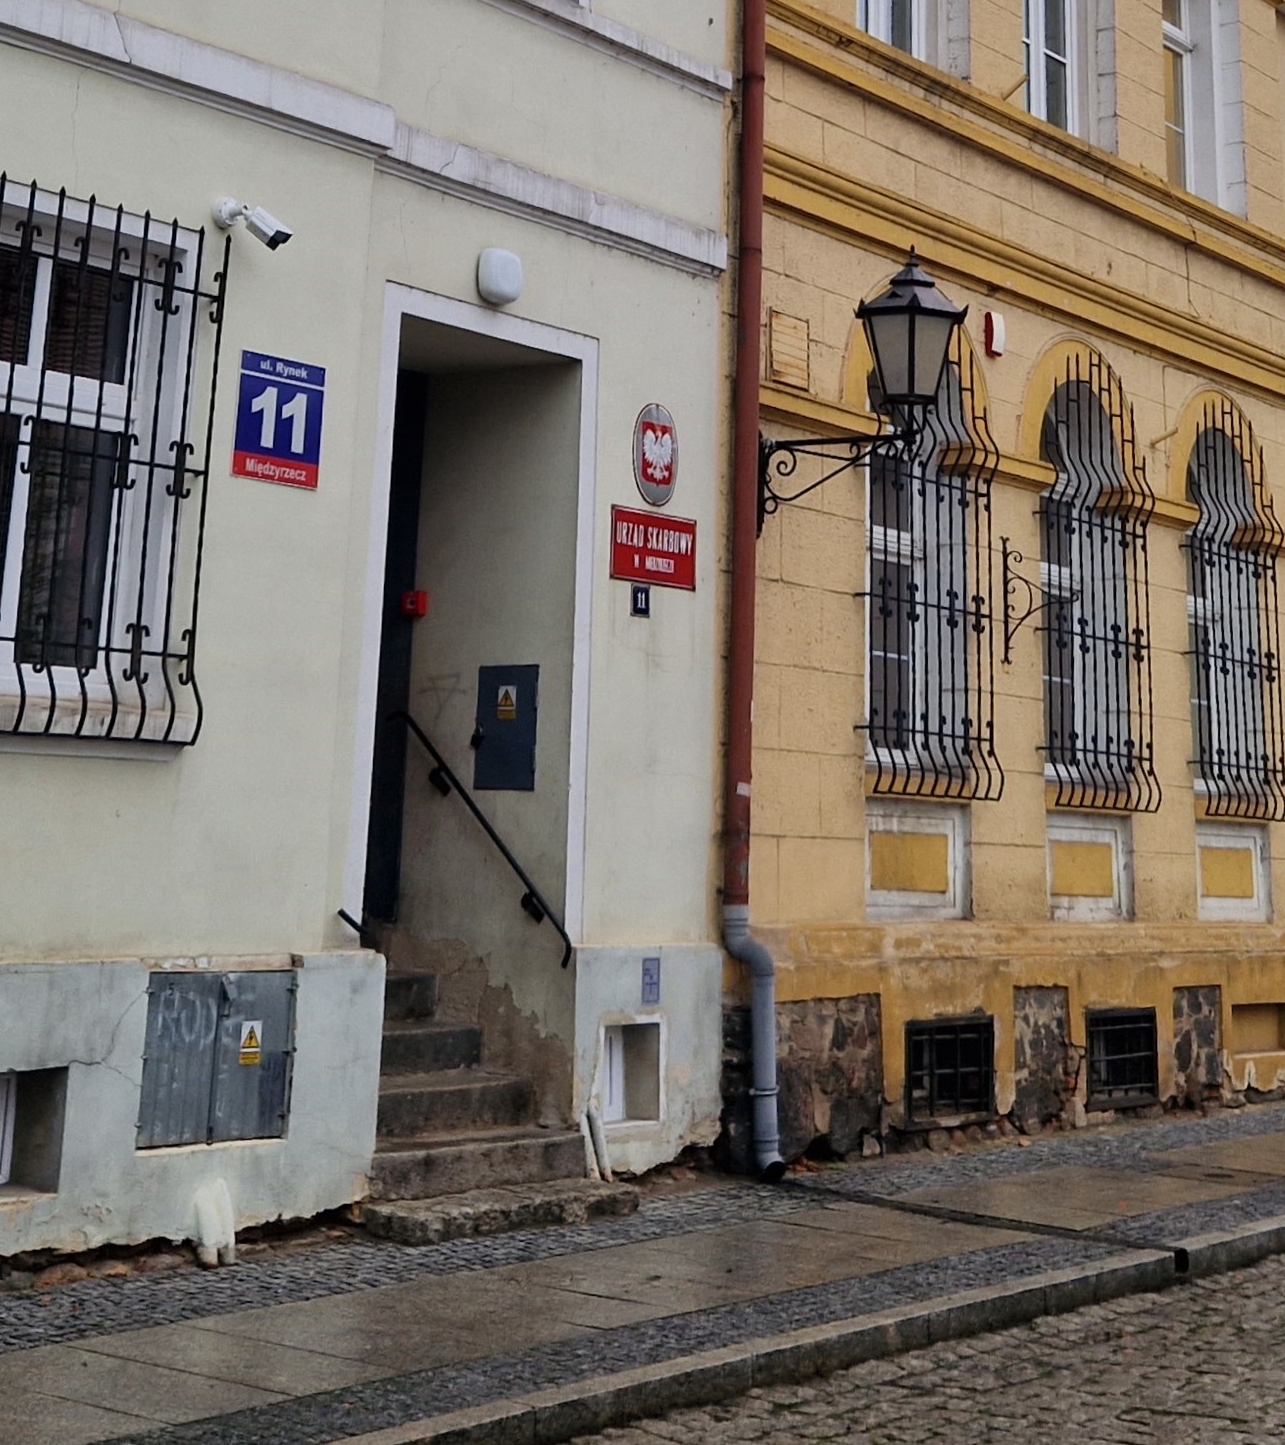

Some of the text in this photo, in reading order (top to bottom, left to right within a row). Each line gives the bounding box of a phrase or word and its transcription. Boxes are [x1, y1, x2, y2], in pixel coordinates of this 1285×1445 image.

[260, 359, 308, 380] ul. Rynek
[251, 385, 308, 454] 11
[245, 457, 307, 482] Międzyrzecz
[617, 521, 693, 556] URZĄD SKARBOWY
[637, 591, 646, 609] 11
